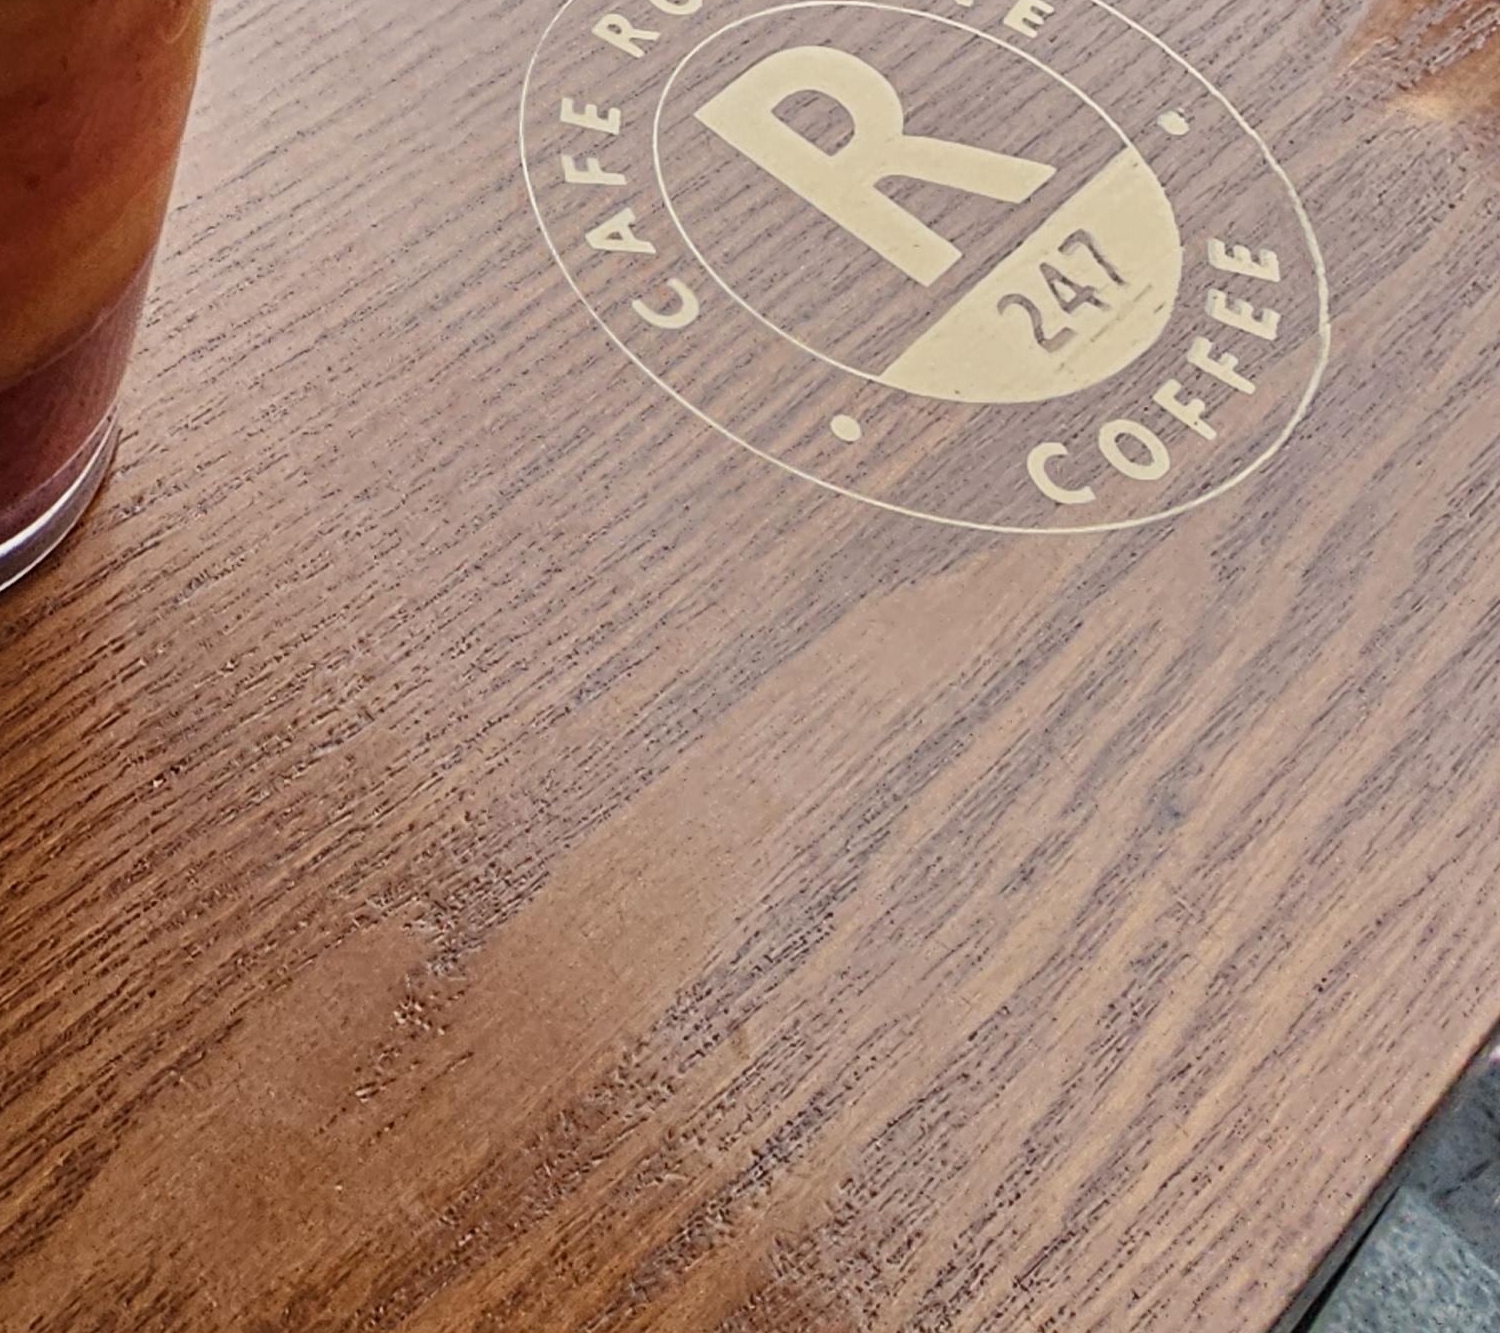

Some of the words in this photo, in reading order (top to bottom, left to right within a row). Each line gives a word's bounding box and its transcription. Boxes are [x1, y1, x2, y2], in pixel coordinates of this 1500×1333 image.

[560, 96, 700, 331] CAFE
[693, 44, 1058, 288] R
[997, 227, 1129, 354] 247
[1026, 237, 1284, 506] COFFEE
